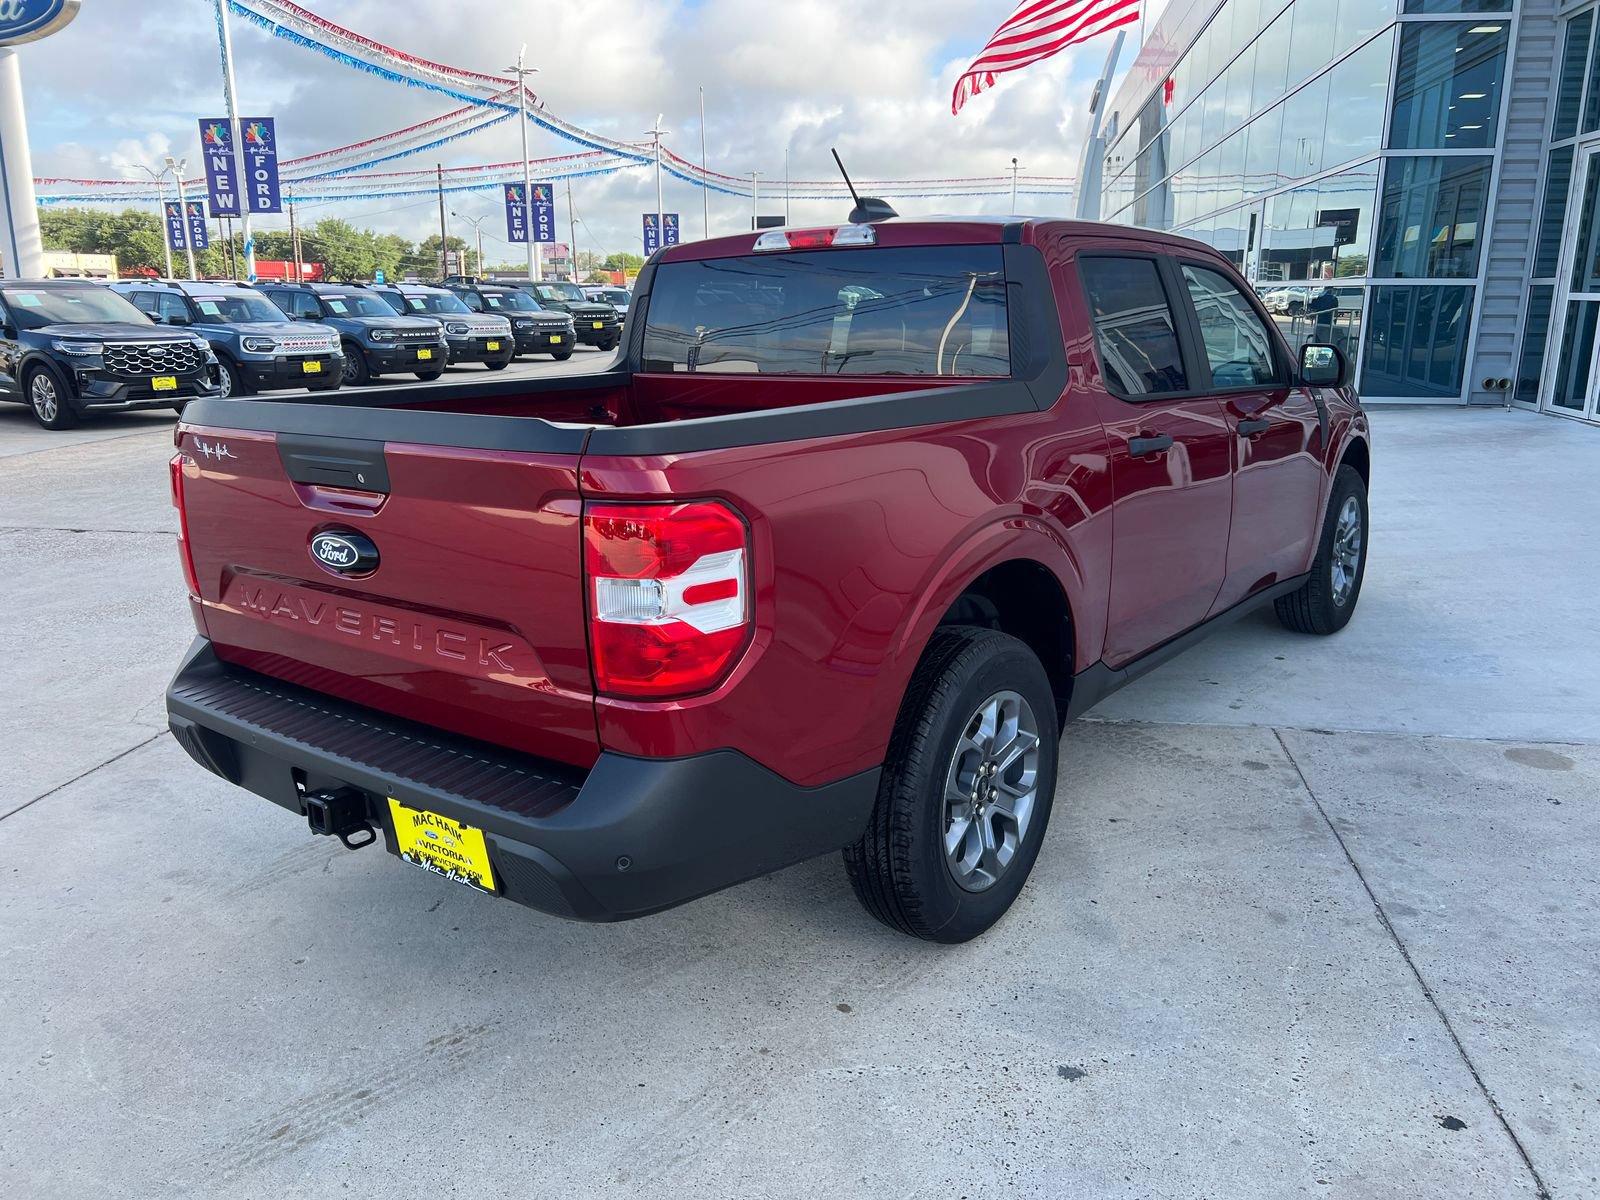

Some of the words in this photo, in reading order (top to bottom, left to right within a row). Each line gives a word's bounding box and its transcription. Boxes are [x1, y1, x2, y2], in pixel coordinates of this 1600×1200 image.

[212, 156, 234, 208] NEW
[254, 155, 271, 209] FORD
[172, 220, 184, 248] NEW
[193, 220, 204, 248] FORD
[512, 207, 525, 240] NEW
[538, 206, 549, 240] FORD
[320, 540, 348, 563] Ford
[239, 584, 515, 671] MAVERICK
[412, 813, 434, 828] MAC
[434, 816, 465, 846] HAIK
[420, 859, 445, 877] Mac
[421, 839, 466, 864] VICTORIA
